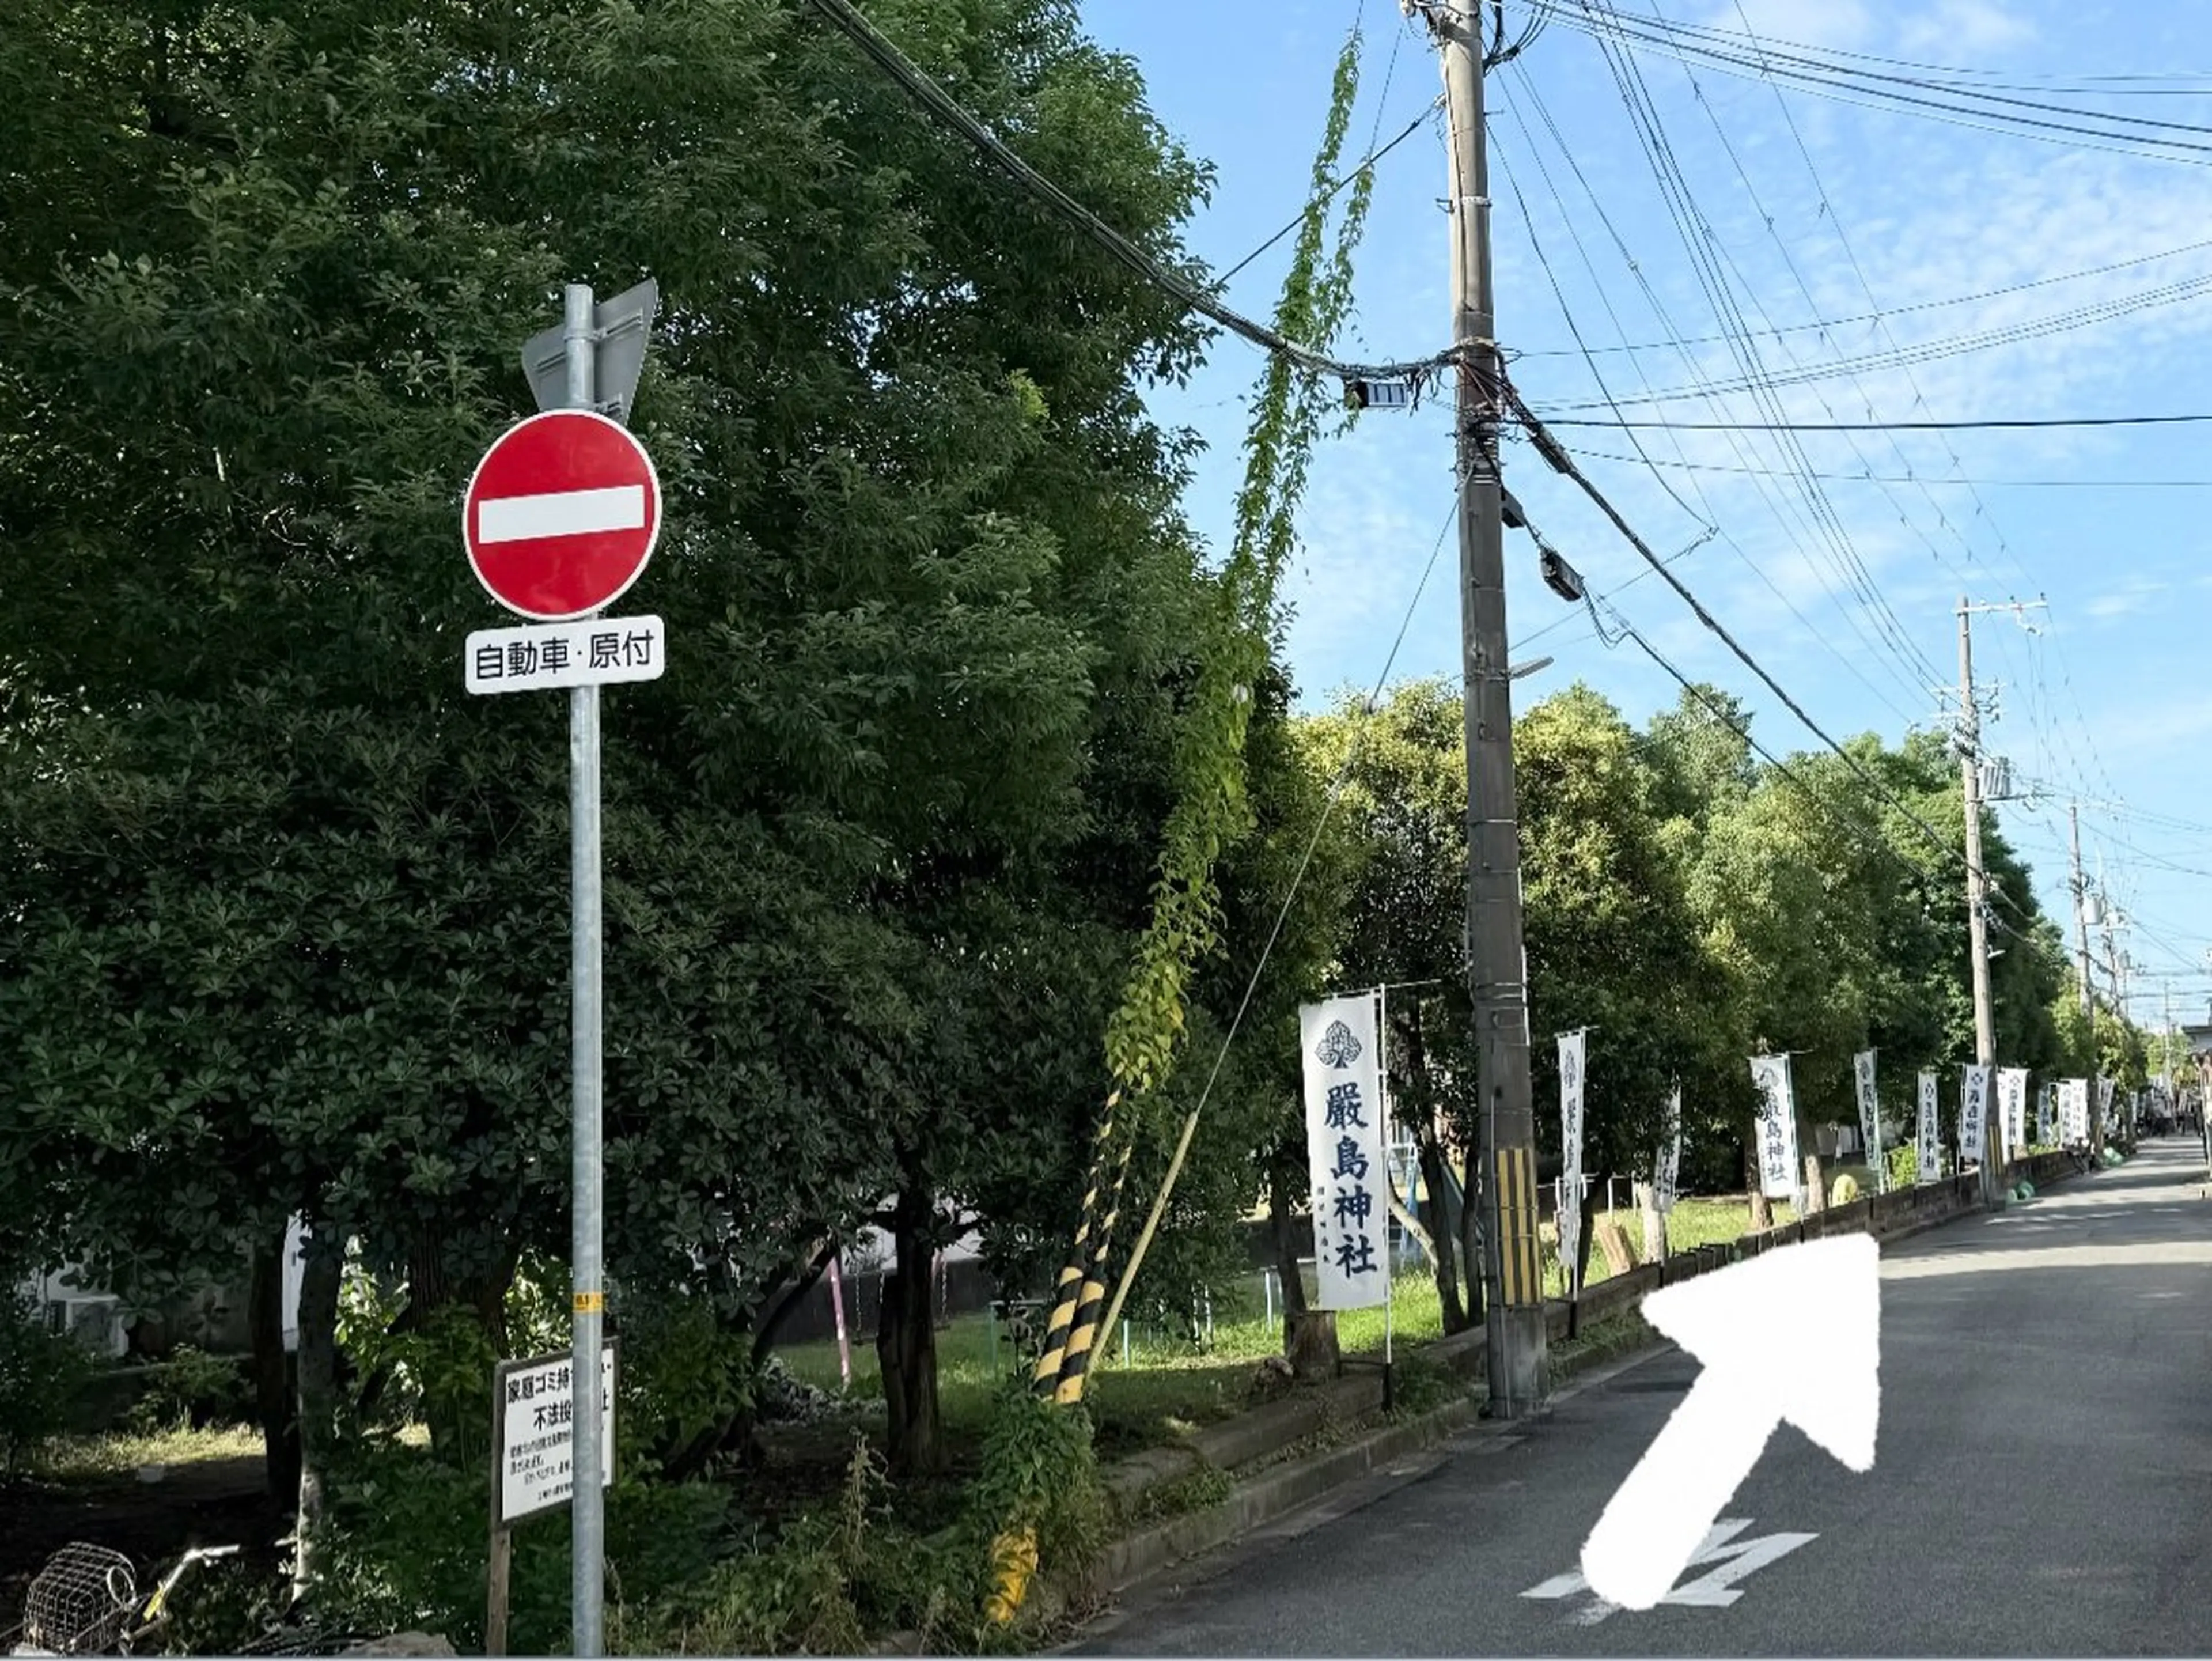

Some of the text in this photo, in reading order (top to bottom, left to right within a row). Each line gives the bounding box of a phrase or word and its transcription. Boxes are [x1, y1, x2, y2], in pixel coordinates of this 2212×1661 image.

[476, 629, 654, 679] 自動車・原付
